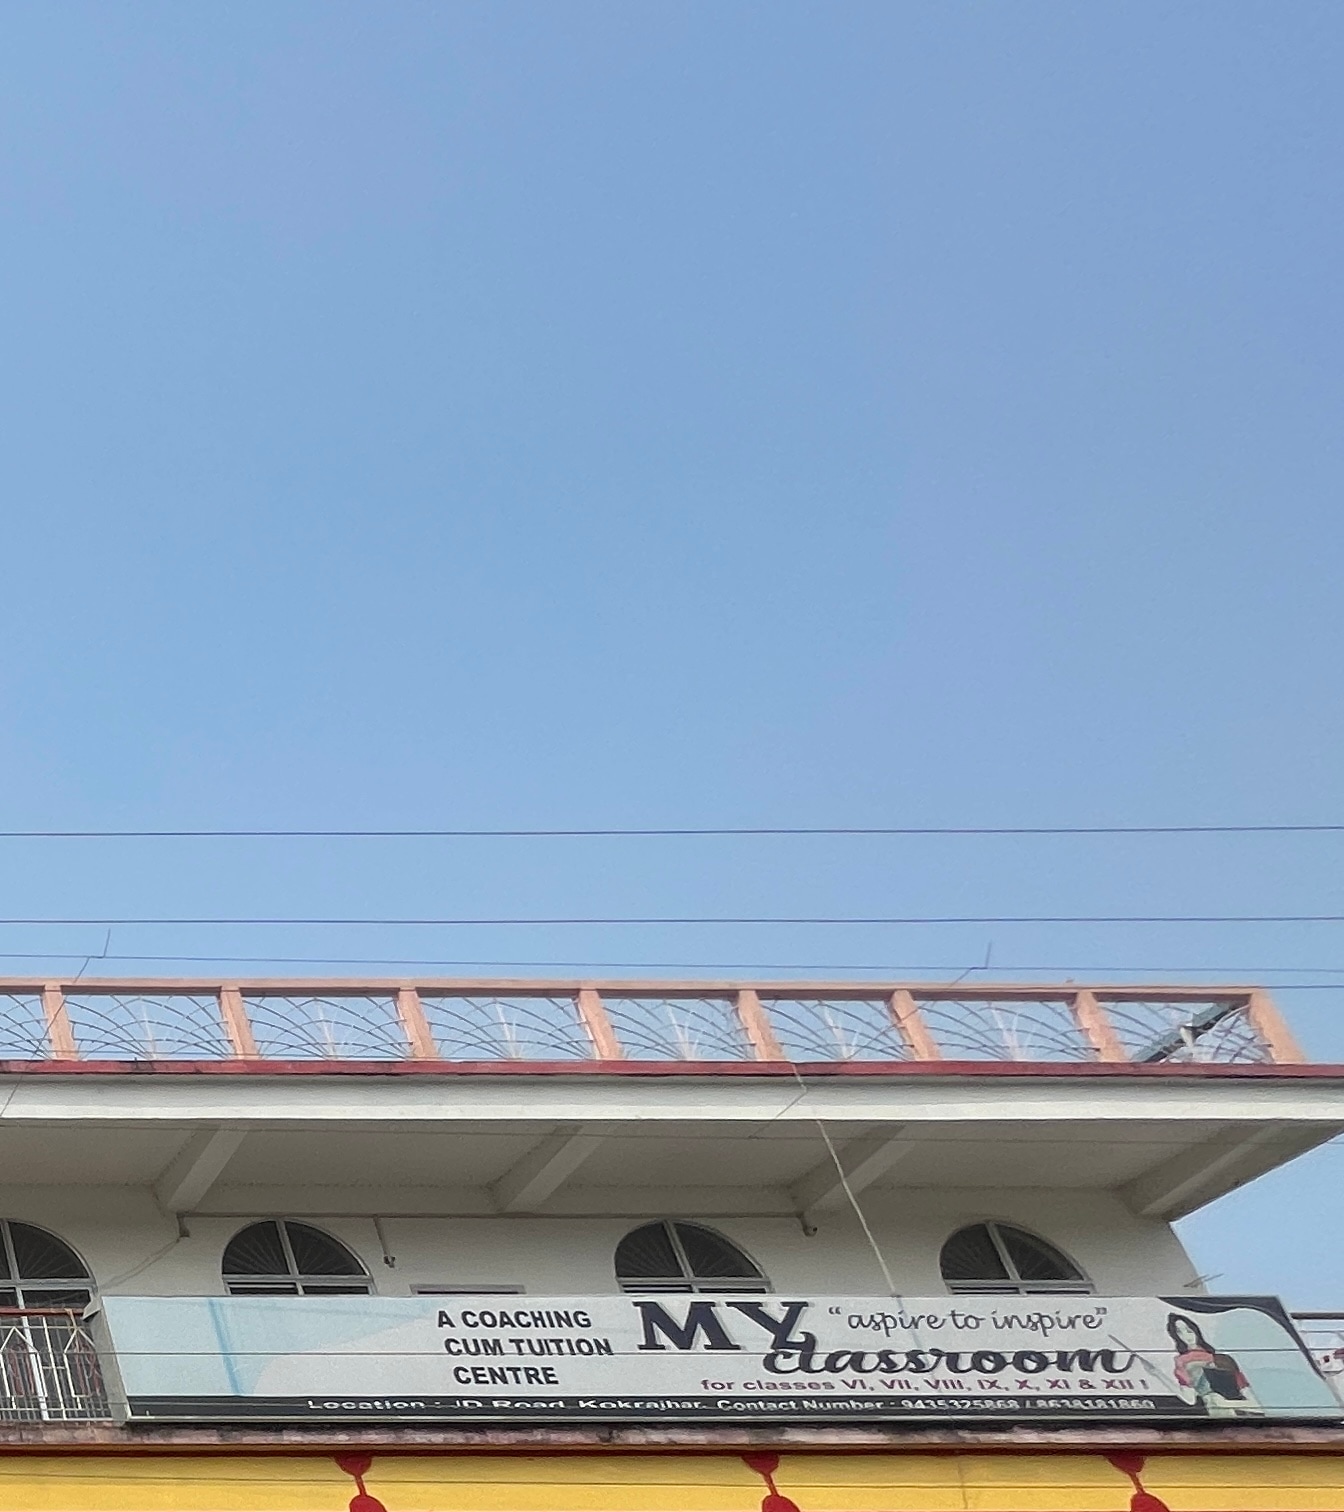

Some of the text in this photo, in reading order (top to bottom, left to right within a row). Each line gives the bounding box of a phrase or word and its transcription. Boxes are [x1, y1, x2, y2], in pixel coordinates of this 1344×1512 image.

[437, 1310, 592, 1328] A COACHING
[632, 1301, 809, 1351] MY
[950, 1309, 986, 1330] to
[444, 1338, 615, 1356] CUM TUITION
[453, 1366, 560, 1385] CENTRE
[701, 1379, 736, 1391] for
[743, 1379, 835, 1391] classes
[1046, 1379, 1070, 1390] XI
[1079, 1379, 1095, 1390] &
[492, 1400, 564, 1410] Road
[717, 1400, 798, 1412] Contact
[802, 1400, 884, 1412] Number
